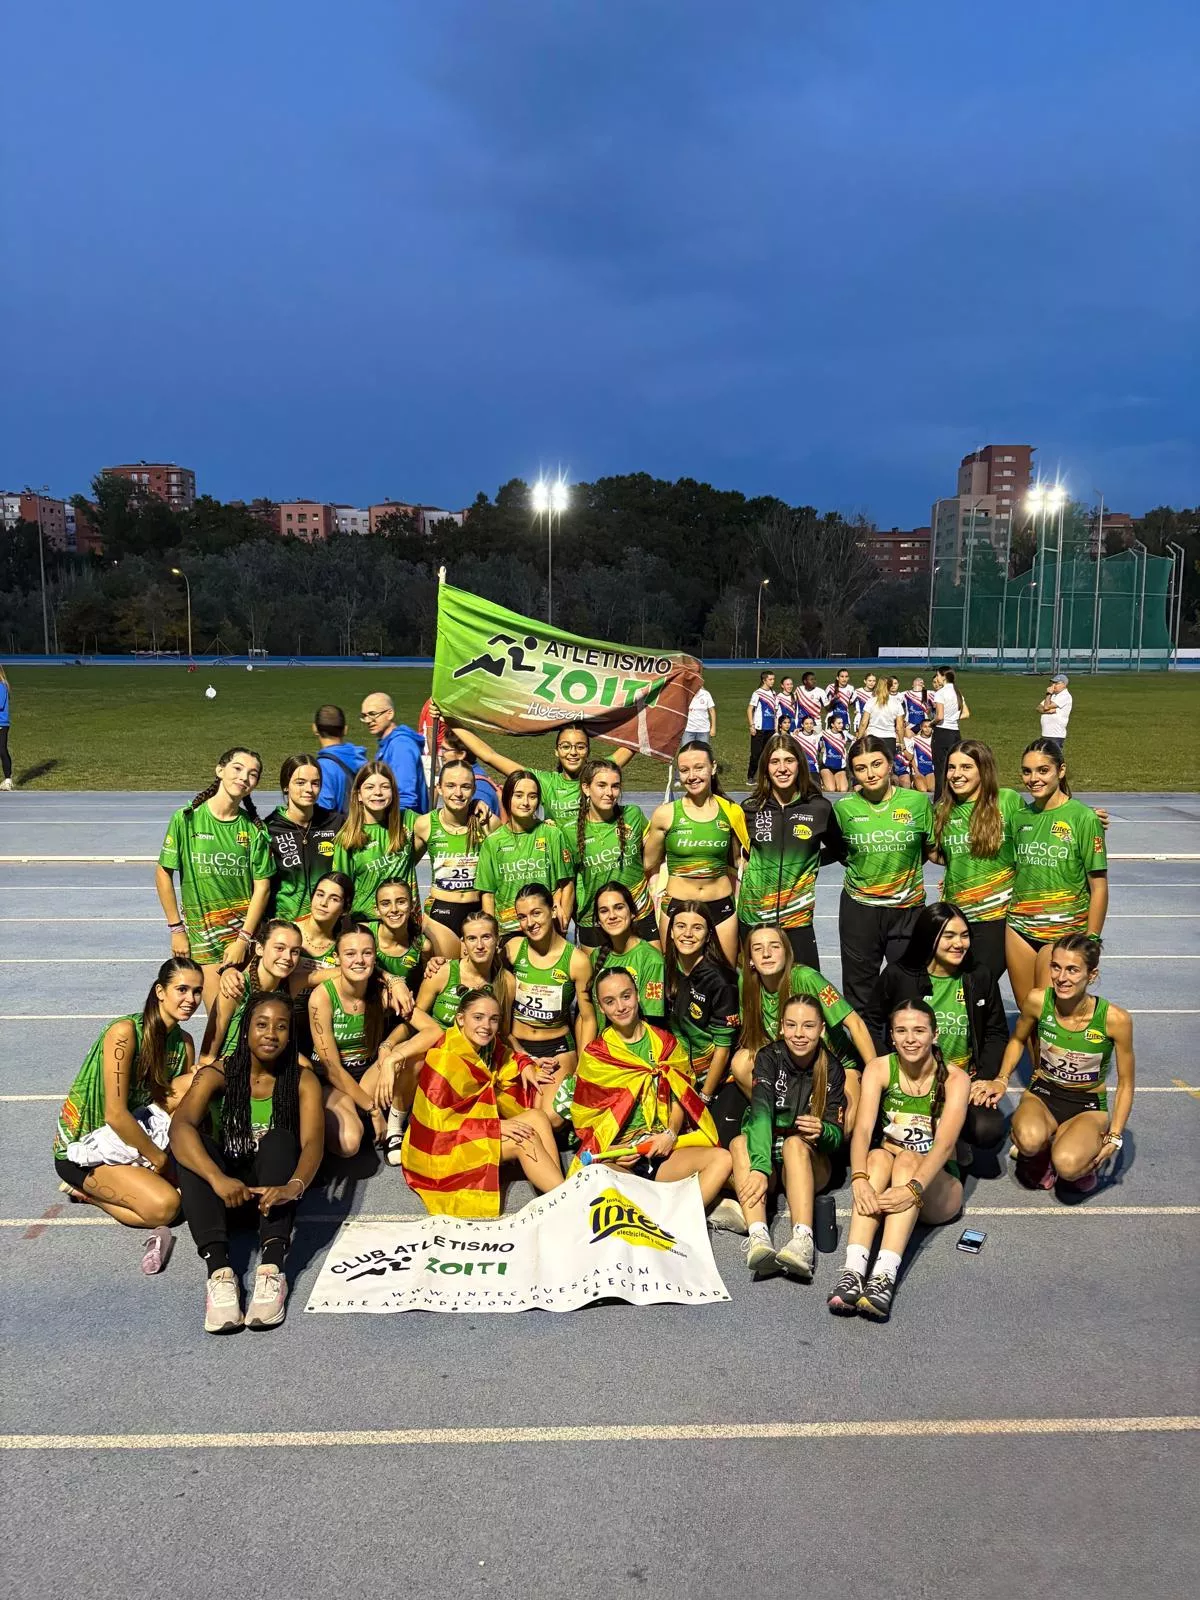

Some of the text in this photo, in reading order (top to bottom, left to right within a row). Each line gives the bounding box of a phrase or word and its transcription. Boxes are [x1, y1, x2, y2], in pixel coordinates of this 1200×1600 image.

[544, 640, 672, 674] ATLETISMO
[533, 661, 667, 707] ZOITI
[677, 838, 728, 848] Huesca
[850, 830, 915, 844] Huesca
[452, 868, 469, 879] 25
[525, 995, 543, 1009] 25
[1057, 1058, 1079, 1074] 25
[903, 1127, 924, 1142] 25
[331, 1235, 515, 1274] CLUB ATLETISMO
[424, 1257, 508, 1276] ZOITI
[583, 1277, 721, 1297] ELECTRICIDAD
